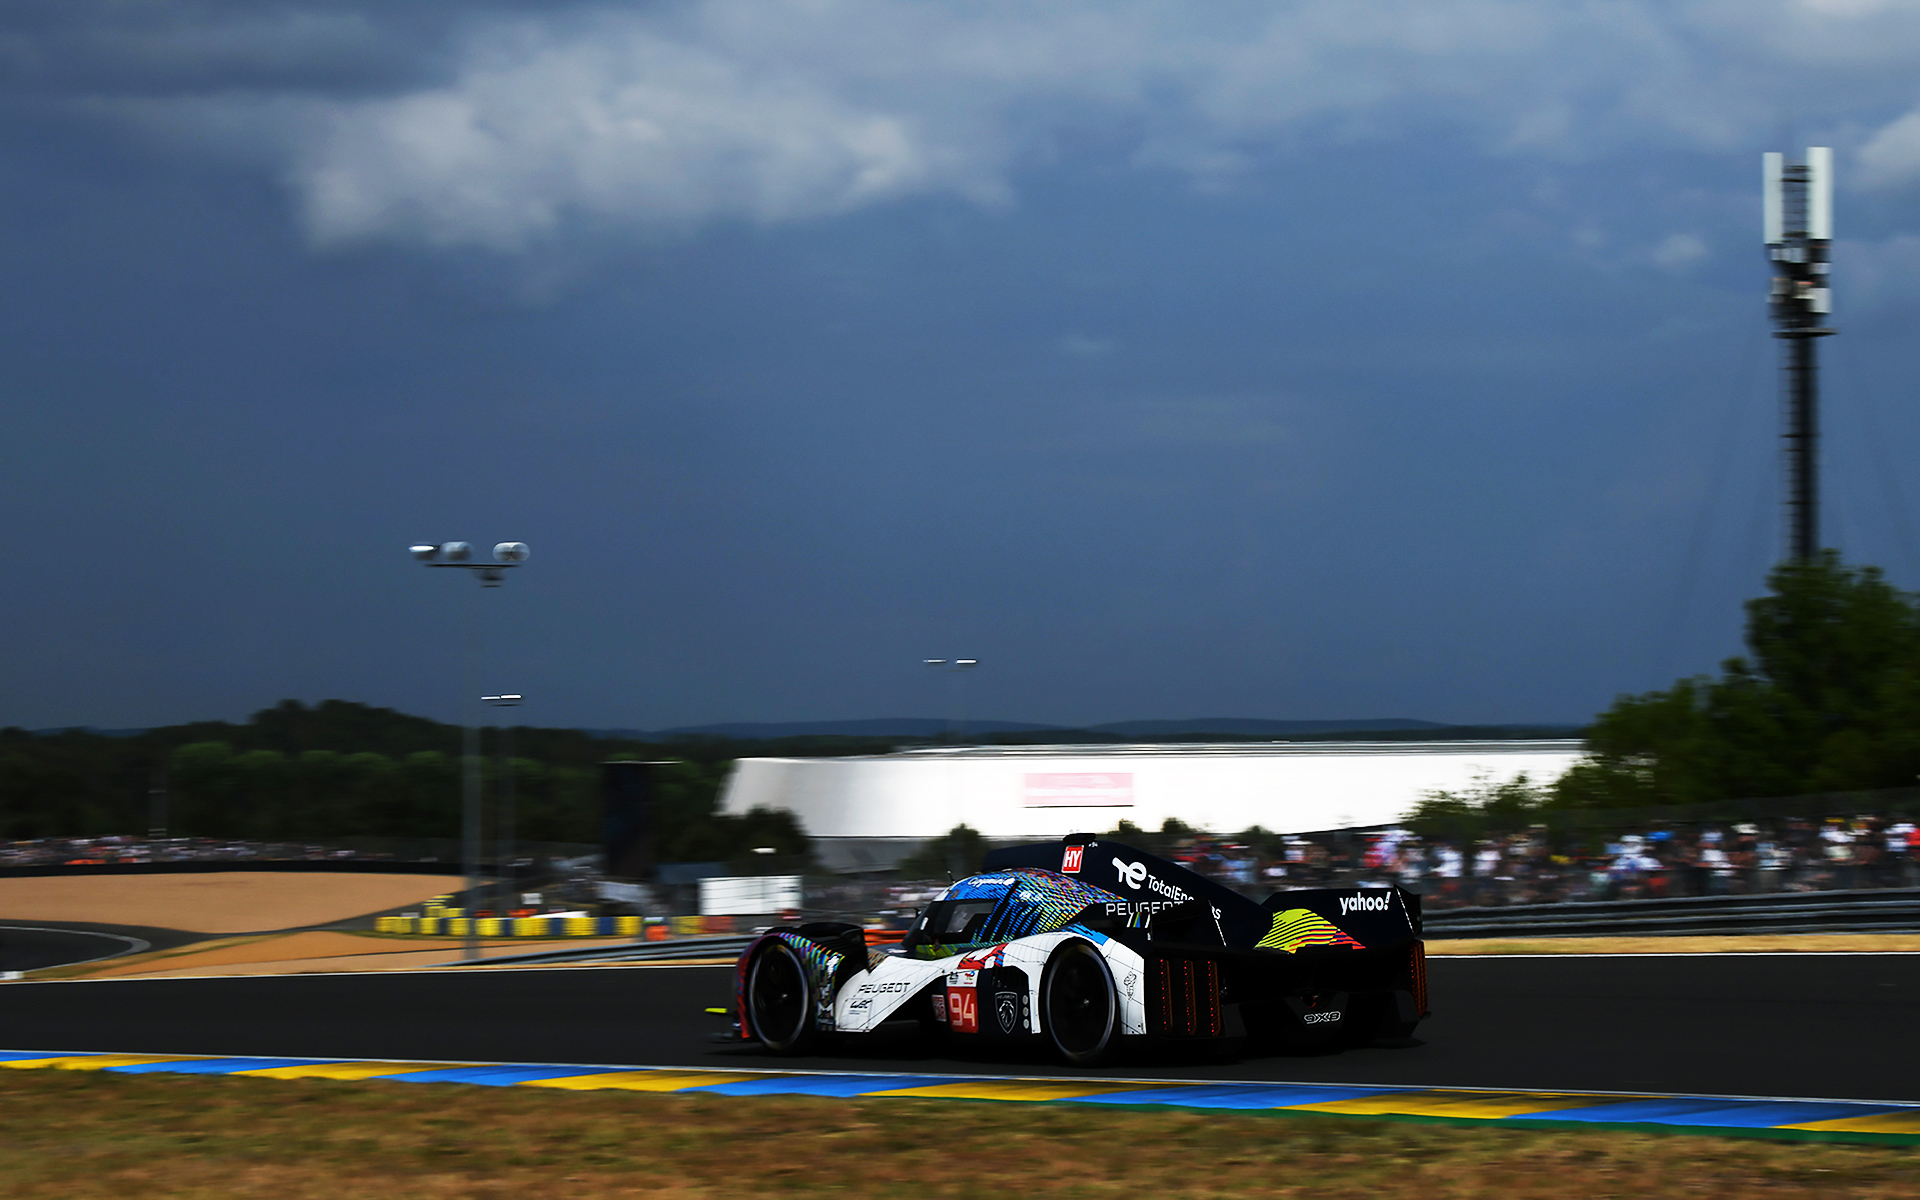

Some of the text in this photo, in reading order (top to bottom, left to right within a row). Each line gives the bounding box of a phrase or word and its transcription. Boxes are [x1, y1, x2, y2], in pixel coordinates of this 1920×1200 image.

[1064, 850, 1082, 867] HY
[1339, 891, 1391, 916] yahoo!
[858, 982, 910, 994] PEUGEOT
[949, 992, 976, 1027] 94
